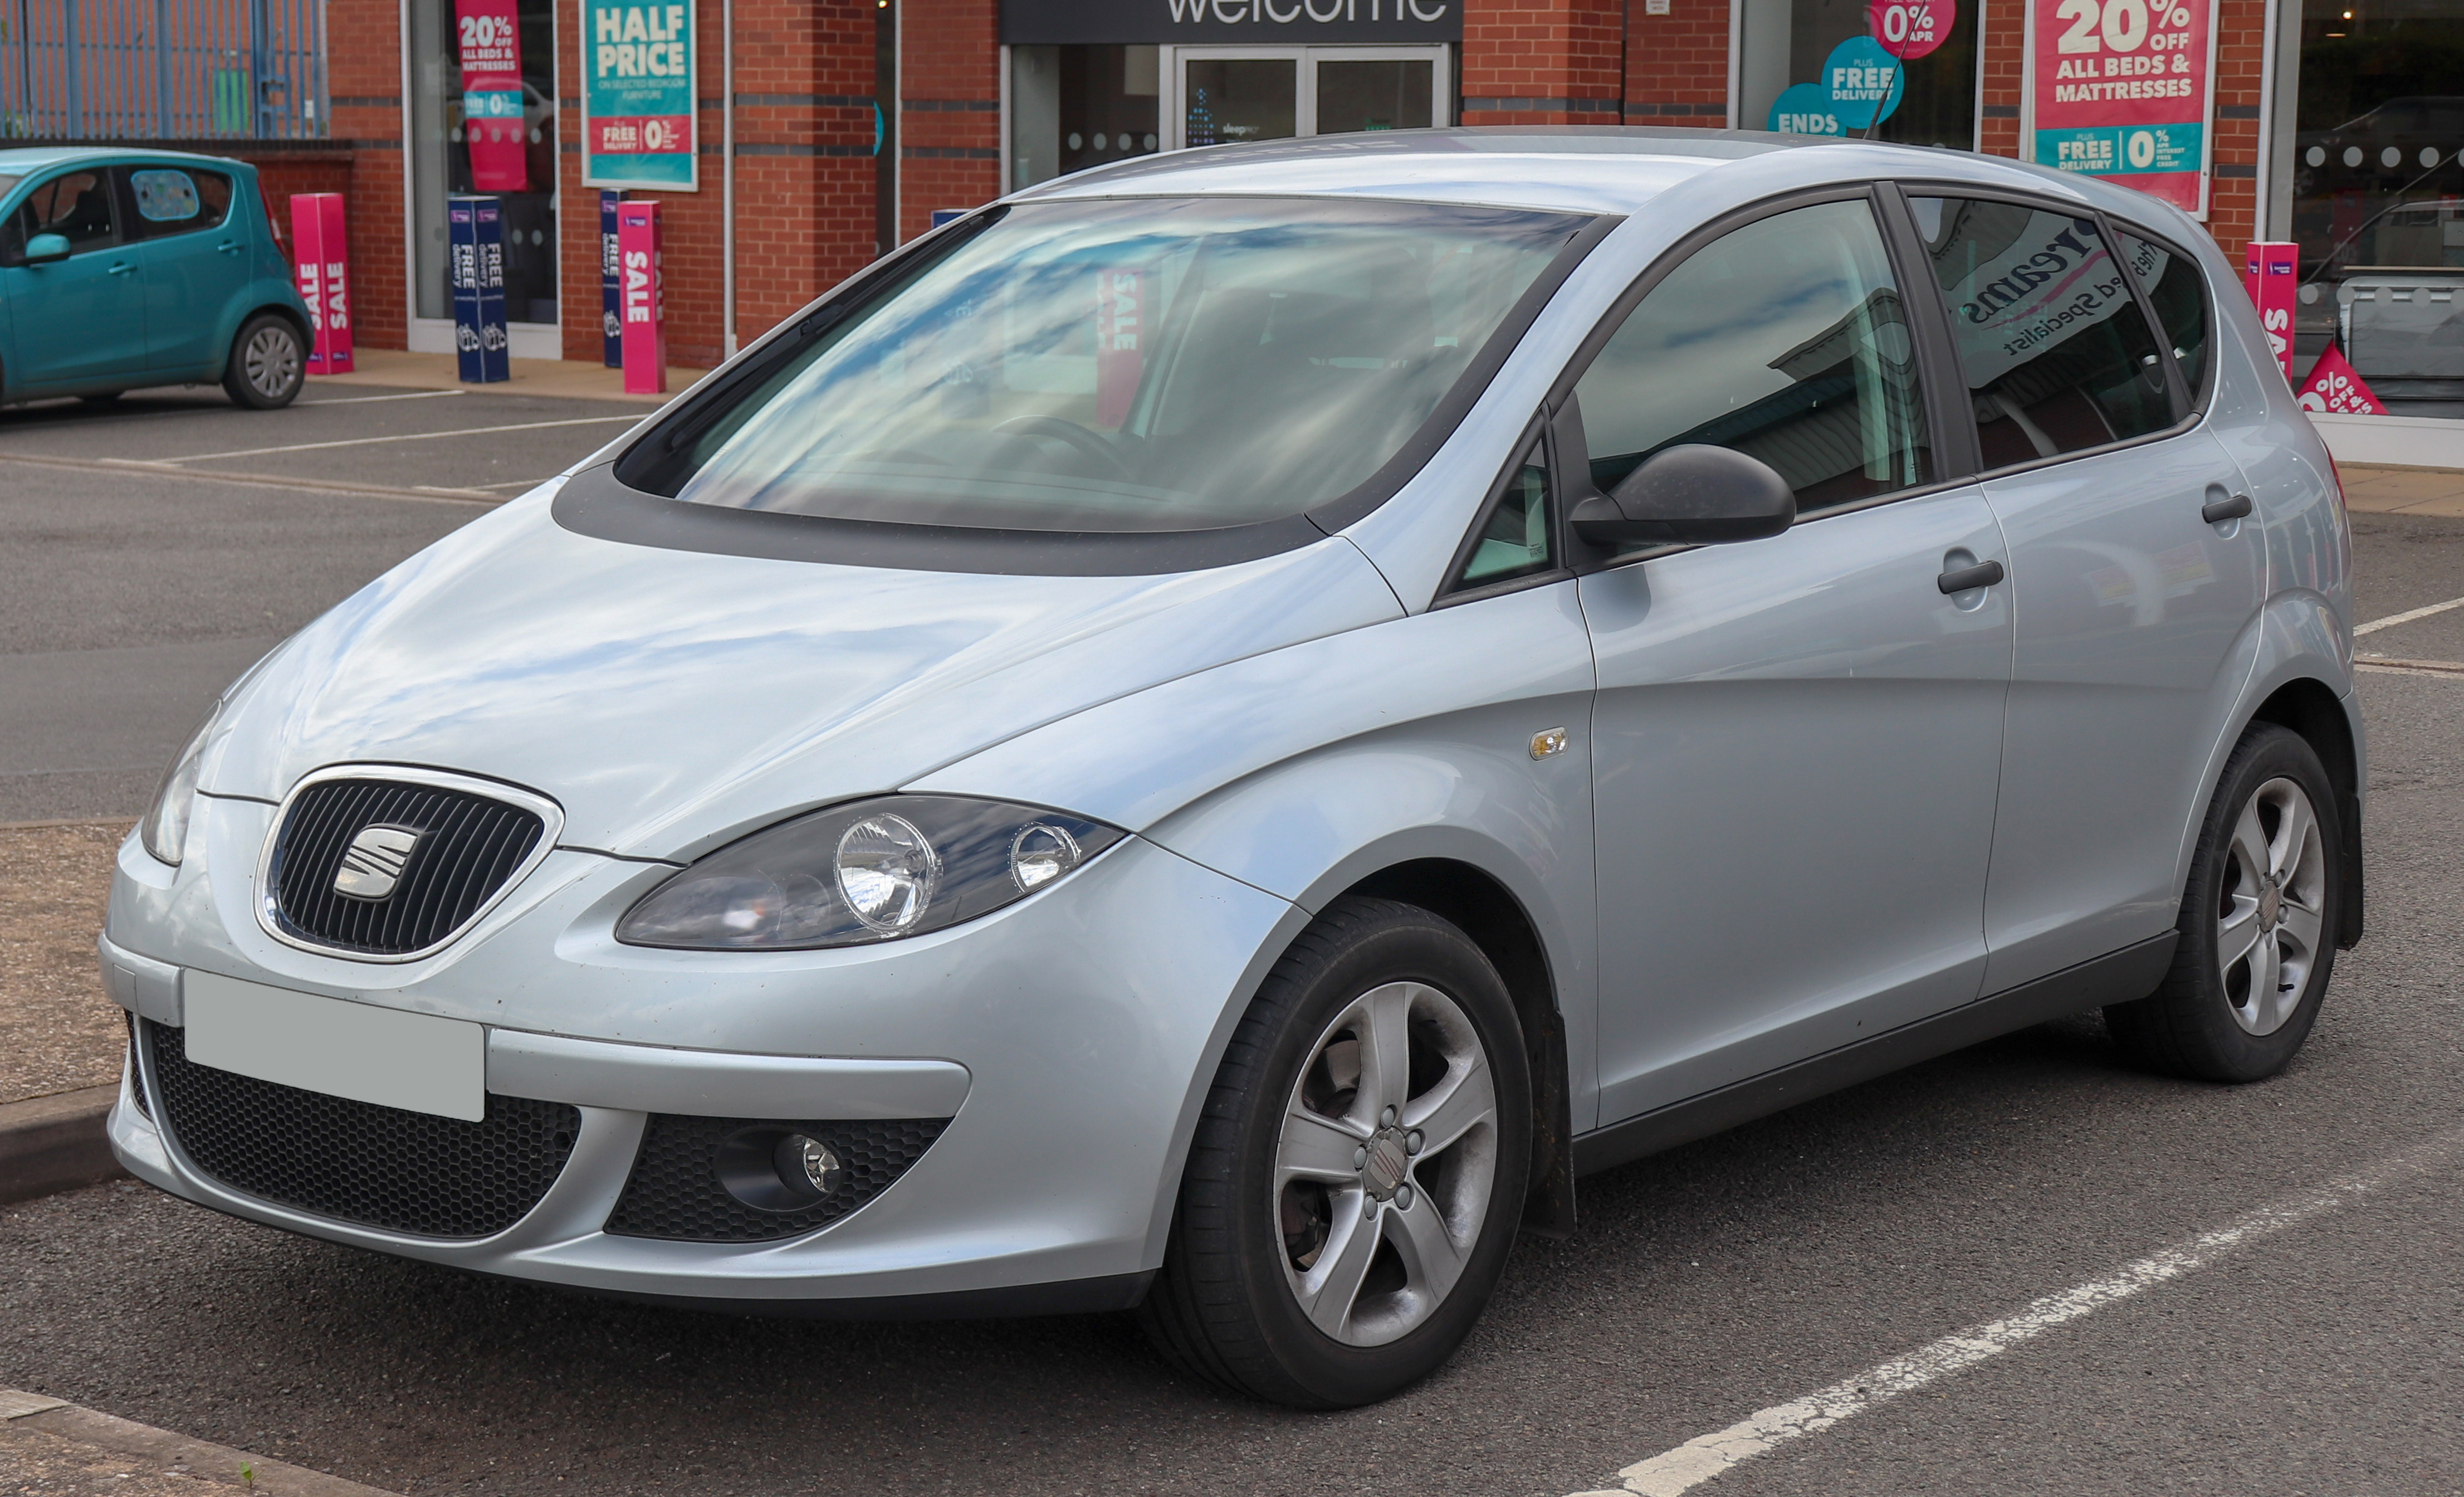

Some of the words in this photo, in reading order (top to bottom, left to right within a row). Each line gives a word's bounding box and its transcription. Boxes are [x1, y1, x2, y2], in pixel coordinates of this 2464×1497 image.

[459, 15, 512, 47] 20%
[596, 5, 684, 43] HALF
[1884, 4, 1934, 42] 0%
[1909, 31, 1934, 42] APR
[2056, 0, 2190, 54] 20%
[462, 49, 476, 59] ALL
[477, 48, 502, 59] BEDS
[505, 48, 514, 58] &
[495, 37, 512, 47] OFF
[2150, 32, 2189, 51] OFF
[462, 61, 516, 71] MATTRESSES
[597, 42, 685, 77] PRICE
[1854, 58, 1874, 67] PLUS
[2056, 58, 2099, 79] ALL
[2105, 55, 2165, 76] BEDS
[2171, 53, 2190, 74] &
[1832, 67, 1894, 89] FREE
[2056, 78, 2192, 102] MATTRESSES
[1832, 89, 1893, 101] DELIVERY
[603, 126, 636, 141] FREE
[1778, 113, 1839, 133] ENDS
[2058, 140, 2112, 160] FREE
[2128, 130, 2169, 168] 0%
[2059, 159, 2112, 170] DELIVERY
[452, 243, 462, 289] delivery
[461, 244, 476, 289] FREE
[478, 243, 488, 289] delivery
[487, 242, 503, 288] FREE
[609, 233, 619, 277] FREE
[326, 262, 348, 330] SALE
[624, 251, 650, 323] SALE
[1113, 273, 1137, 350] SALE
[2264, 308, 2289, 371] SA
[2329, 384, 2355, 408] OFF
